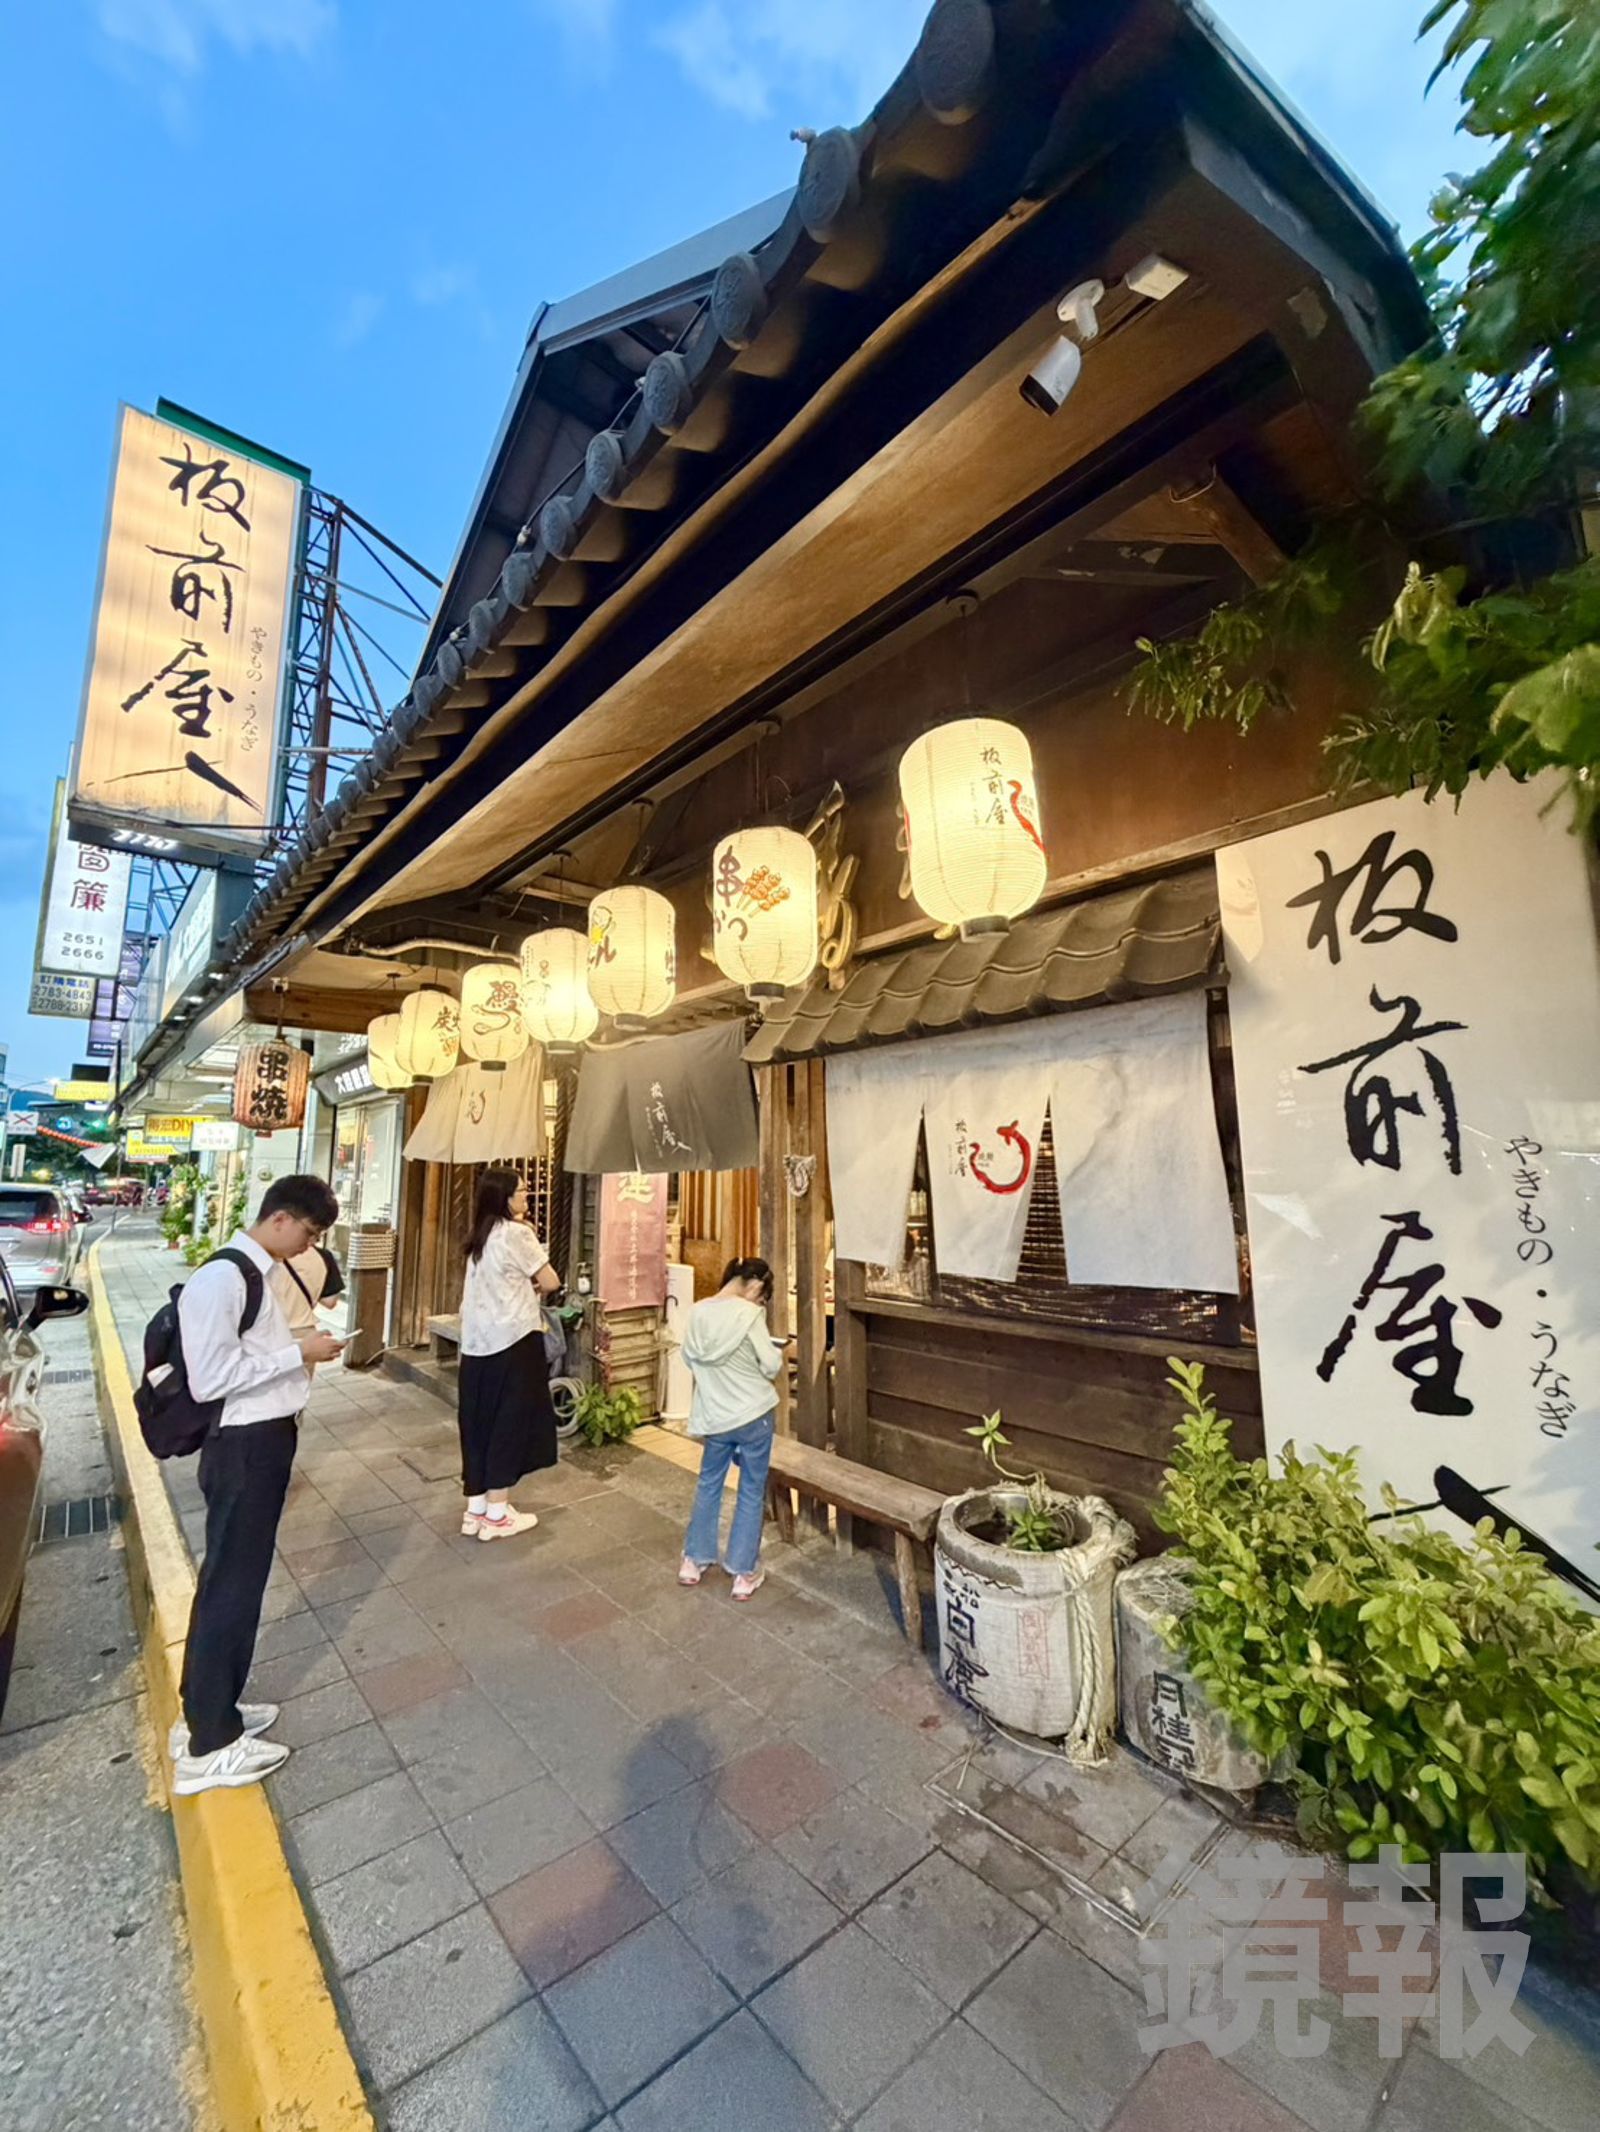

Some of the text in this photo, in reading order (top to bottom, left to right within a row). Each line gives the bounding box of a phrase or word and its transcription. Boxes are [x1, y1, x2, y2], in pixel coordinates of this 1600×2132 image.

[122, 441, 252, 739] 板前屋
[980, 746, 1009, 826] 板前屋
[61, 946, 105, 961] 2666
[62, 931, 104, 946] 2651
[1286, 829, 1503, 1416] 板前屋
